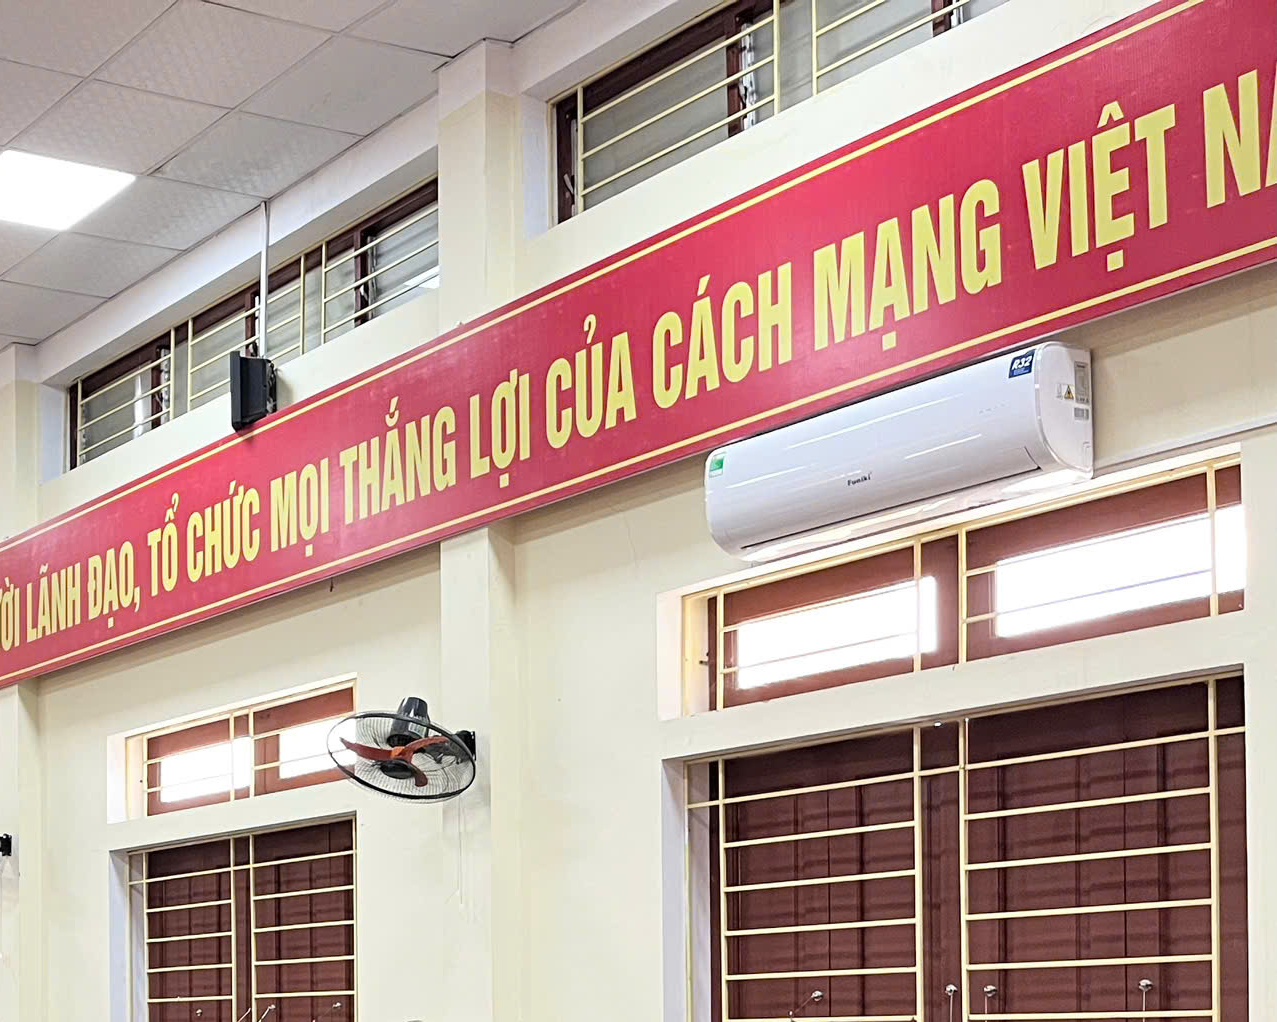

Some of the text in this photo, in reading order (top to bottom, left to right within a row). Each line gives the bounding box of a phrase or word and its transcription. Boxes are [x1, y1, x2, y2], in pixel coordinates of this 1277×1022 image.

[26, 562, 81, 643] LÃNH
[87, 541, 140, 629] ĐẠO,
[147, 492, 179, 597] TỔ
[186, 480, 260, 583] CHỨC
[270, 457, 330, 557] MỌI
[339, 396, 457, 525] THẮNG
[469, 368, 531, 488] LỢI
[545, 314, 637, 449] CỦA
[652, 261, 792, 409] CÁCH
[813, 179, 1002, 352] MẠNG
[1022, 101, 1176, 273] VIỆT
[1202, 62, 1277, 208] N
